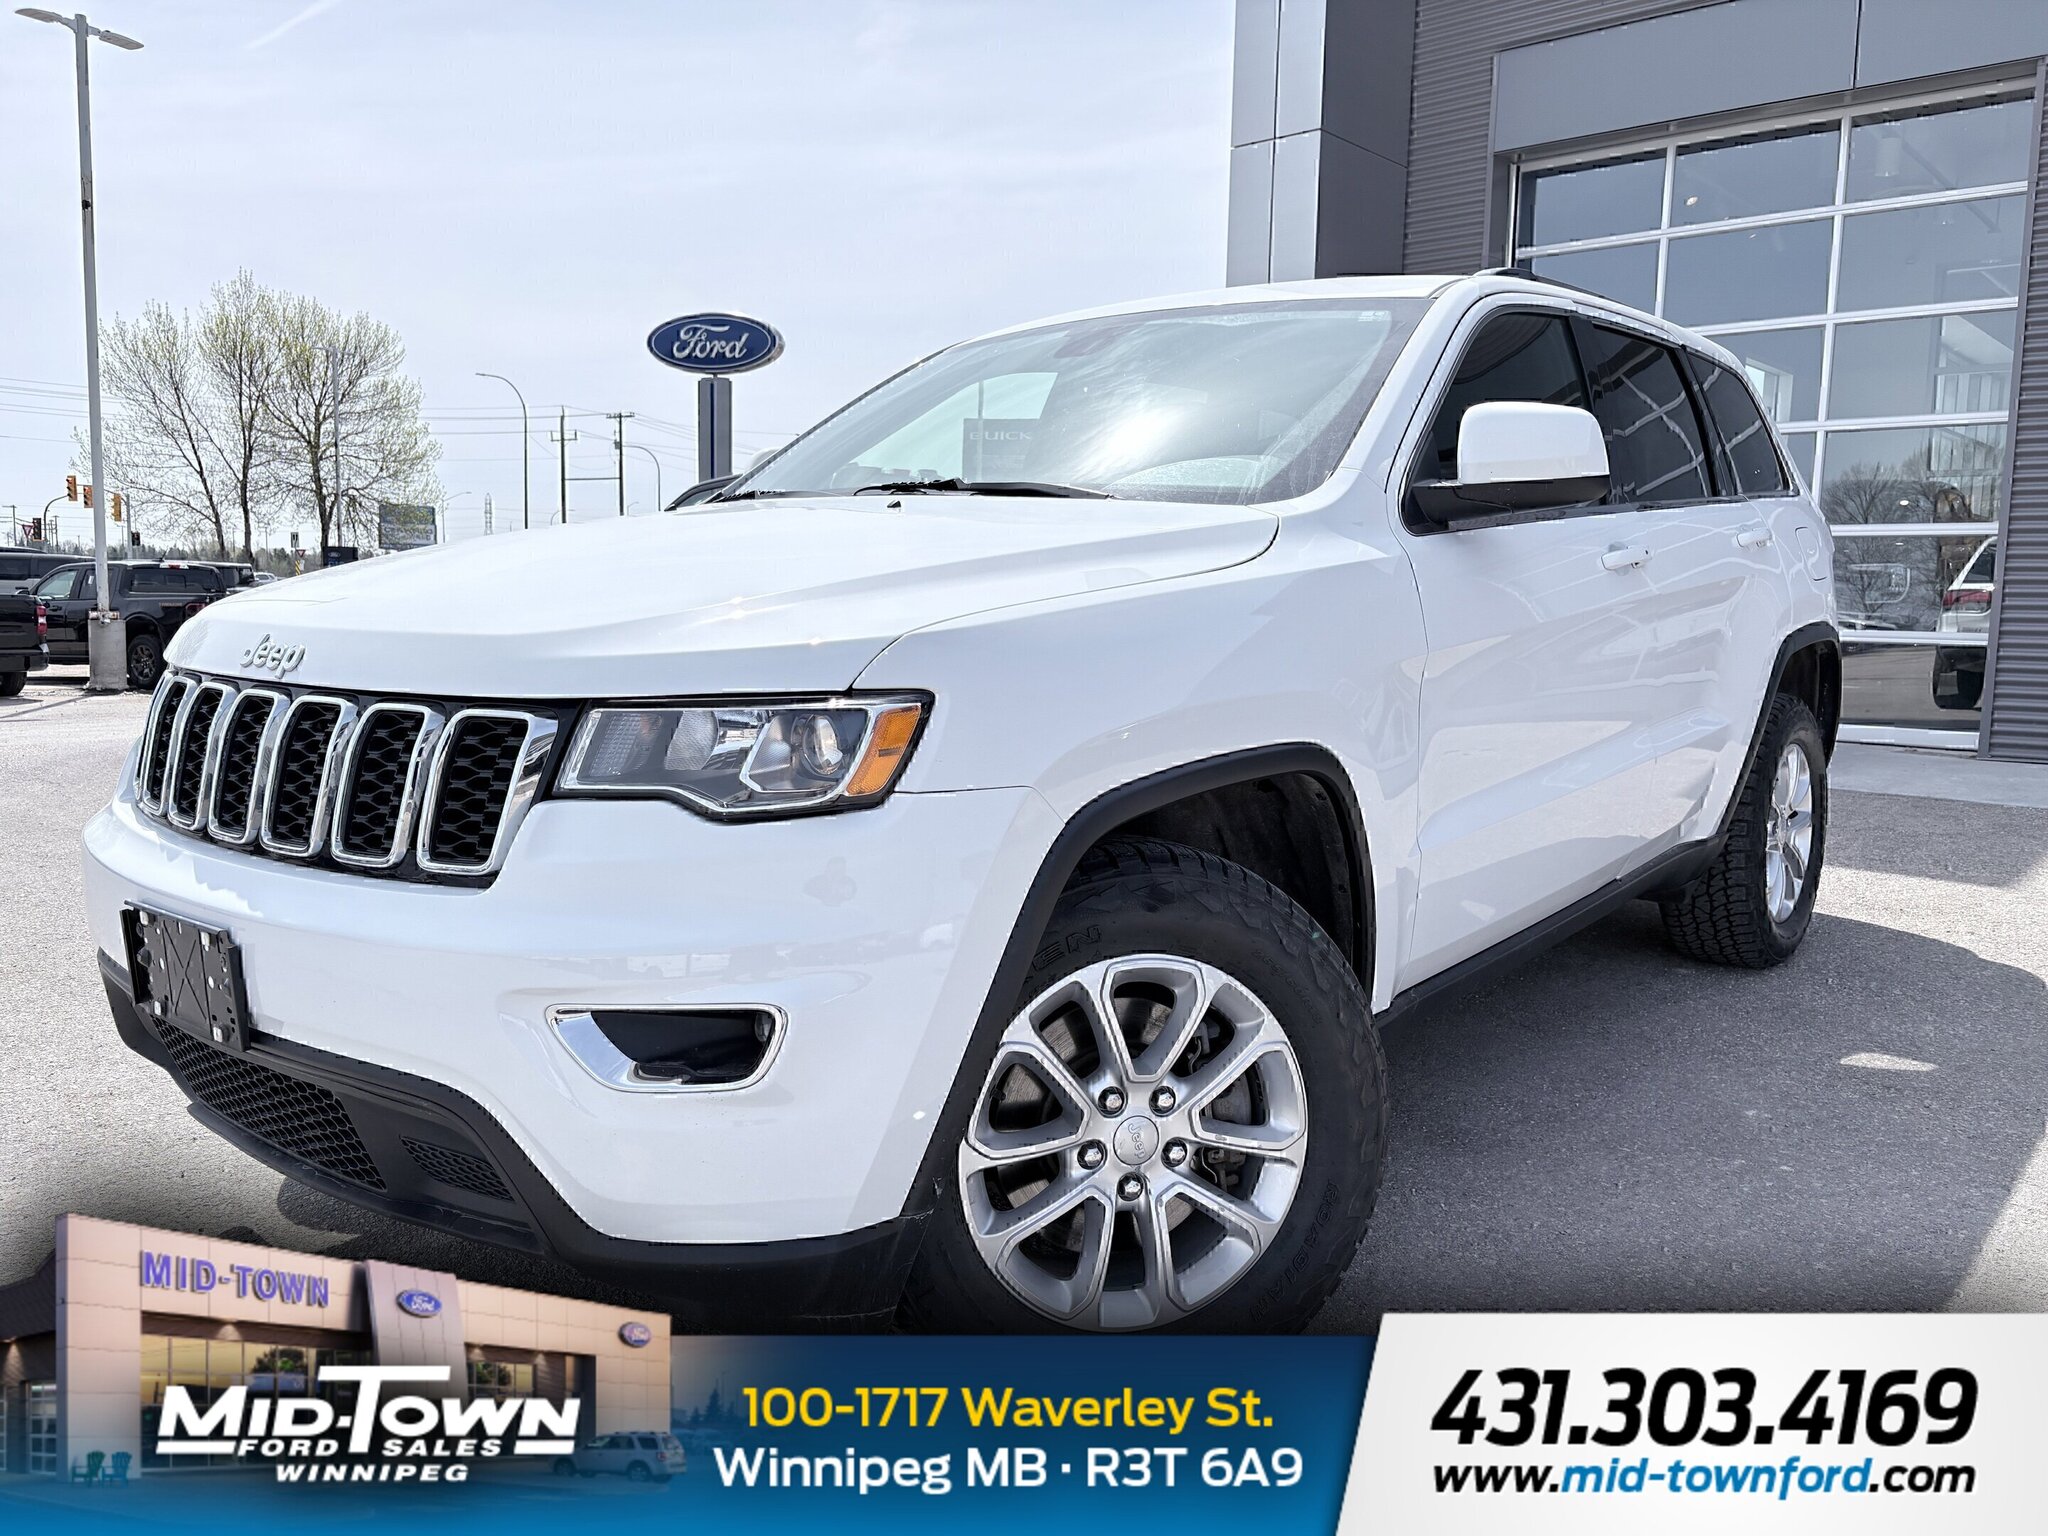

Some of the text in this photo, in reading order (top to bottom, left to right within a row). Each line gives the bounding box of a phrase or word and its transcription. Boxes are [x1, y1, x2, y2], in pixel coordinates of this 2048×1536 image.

[672, 323, 750, 359] Ford
[969, 431, 1033, 440] BUICK
[239, 633, 306, 680] Jeep
[1127, 1122, 1147, 1160] Jeep
